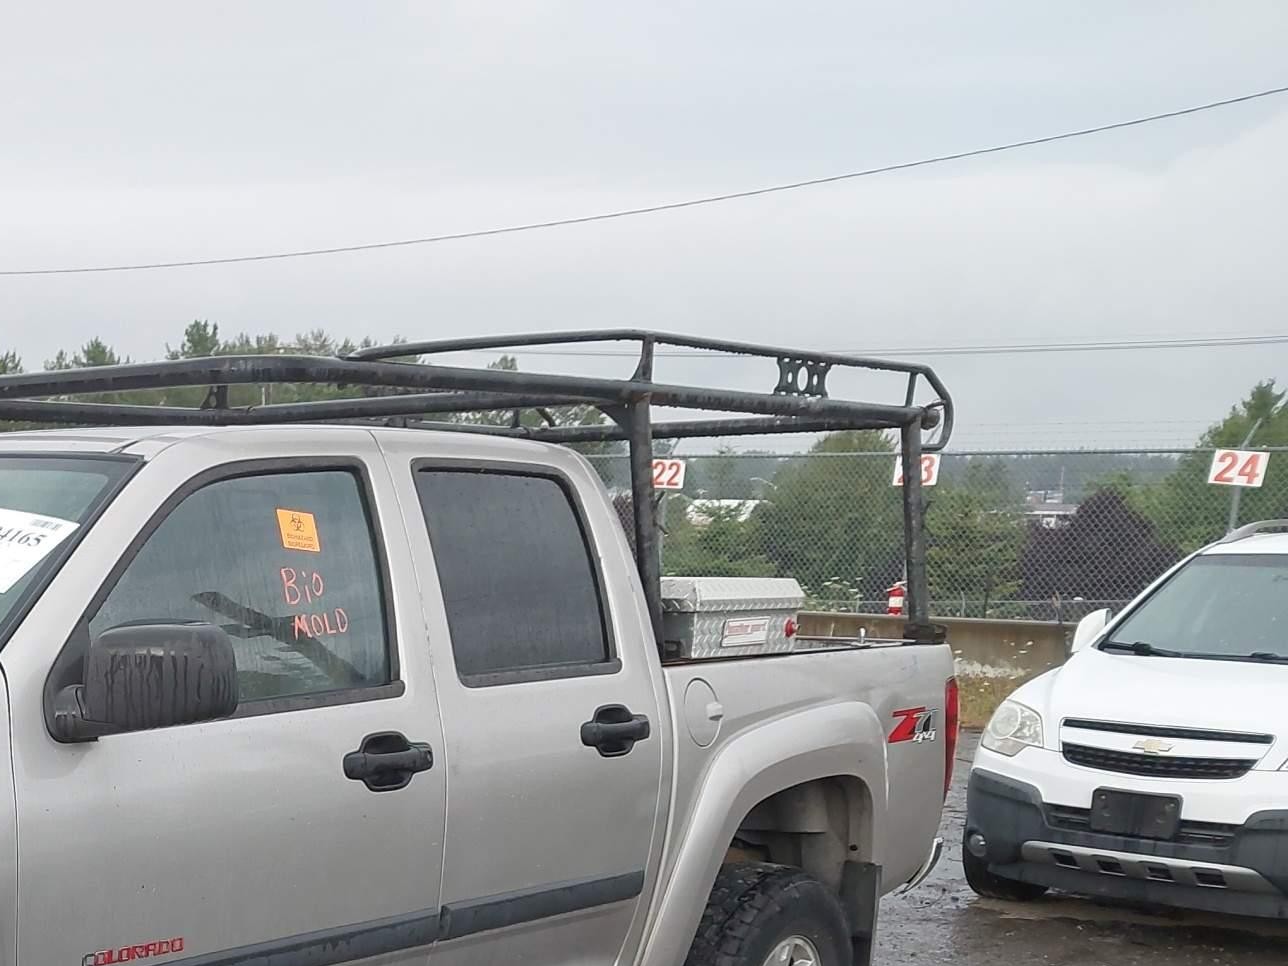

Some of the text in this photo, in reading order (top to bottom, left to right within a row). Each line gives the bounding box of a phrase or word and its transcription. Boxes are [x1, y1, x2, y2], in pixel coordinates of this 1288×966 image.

[652, 461, 680, 486] 22
[1213, 452, 1260, 484] 24
[292, 608, 349, 641] MOLD
